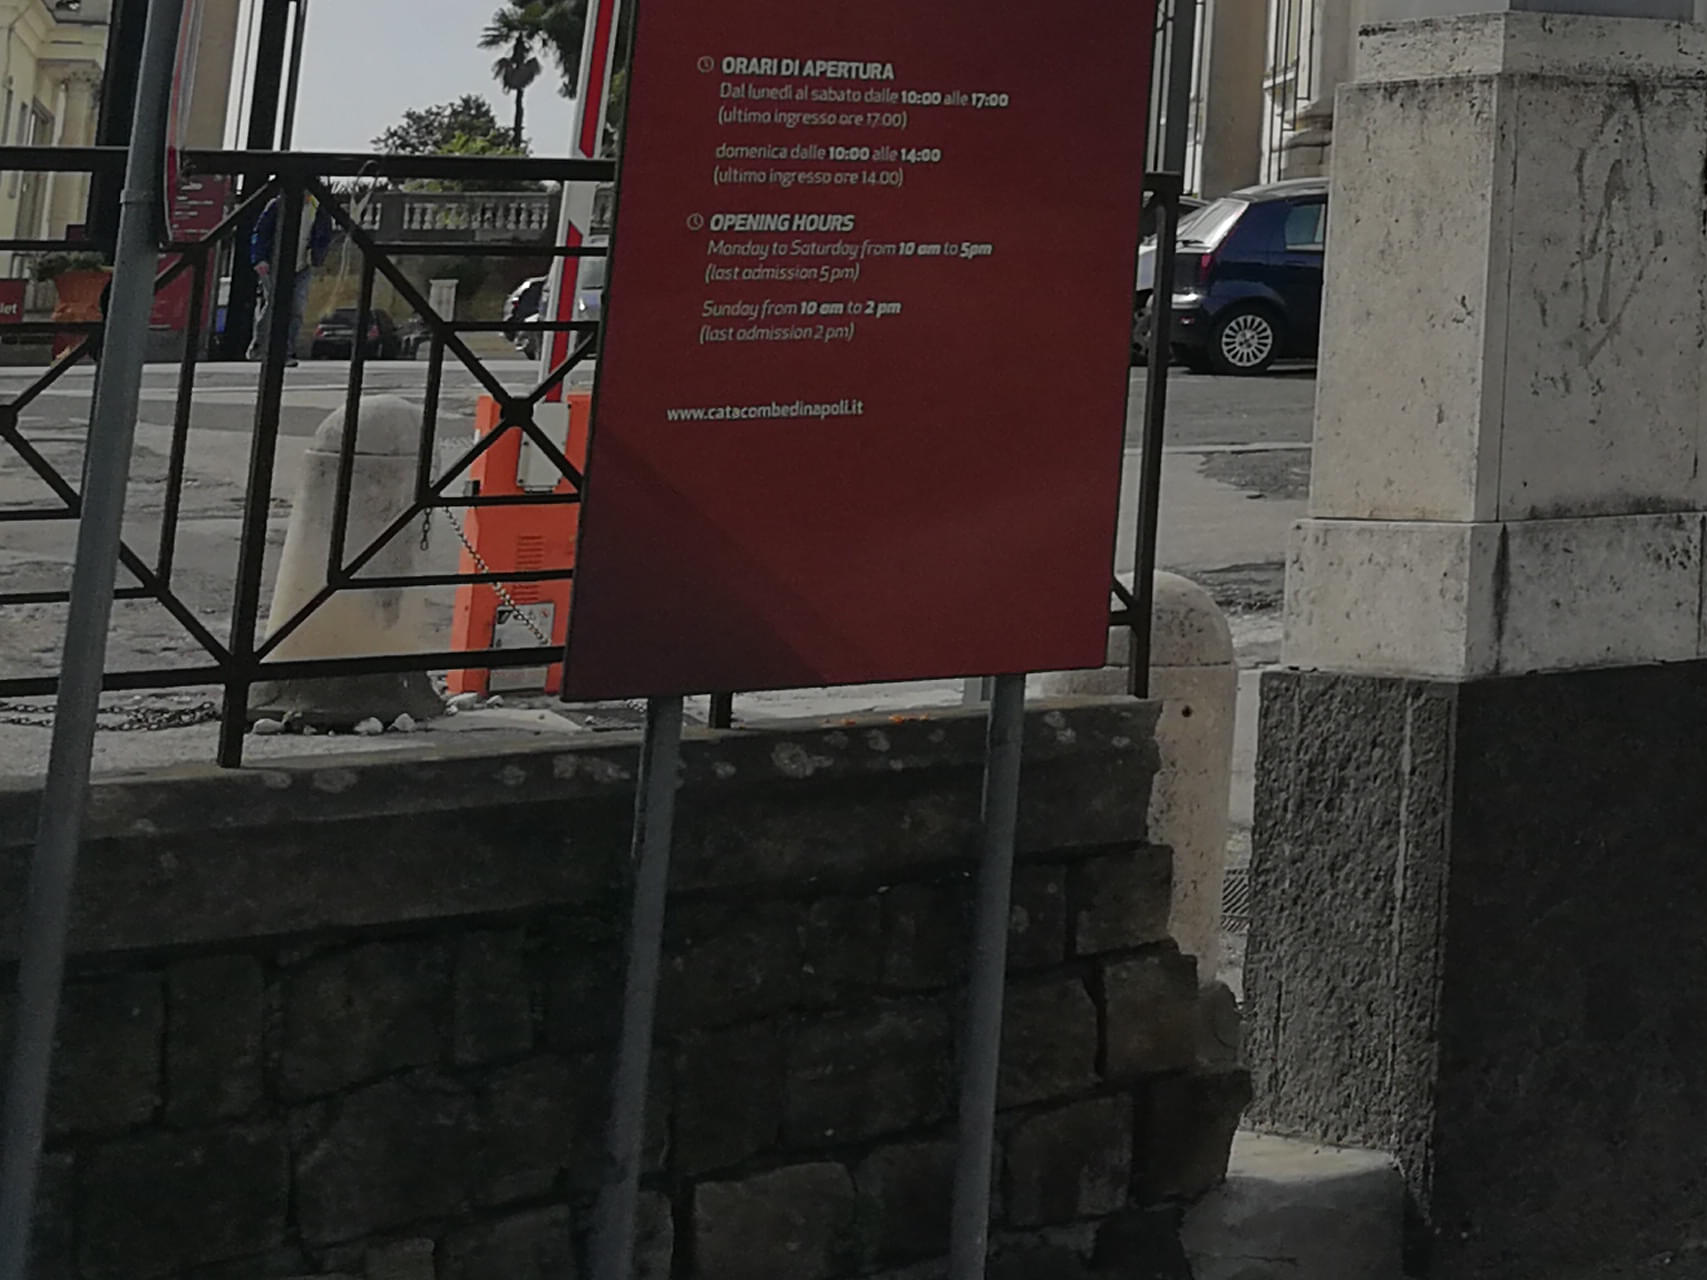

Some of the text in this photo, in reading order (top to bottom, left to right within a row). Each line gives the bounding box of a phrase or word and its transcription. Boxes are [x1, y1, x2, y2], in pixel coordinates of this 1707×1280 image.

[721, 56, 895, 80] ORARI DI APERTURA
[719, 81, 746, 99] Dal
[795, 84, 809, 101] al
[810, 85, 862, 103] sabato
[863, 87, 899, 104] dalle
[901, 90, 942, 106] 10:00
[943, 89, 969, 106] alle
[971, 92, 1010, 109] 17:00
[718, 105, 771, 126] (ultimo
[773, 108, 837, 129] ingresso
[838, 112, 864, 126] ore
[715, 143, 942, 164] domenica dalle 10:00 alle 14:00
[712, 165, 766, 186] (ultimo
[769, 167, 832, 188] ingresso
[833, 170, 859, 185] ore
[709, 213, 856, 233] OPENING HOURS
[706, 238, 993, 261] Monday to Saturday from 10 am to 5pm
[704, 262, 861, 285] (last admission 5 pm)
[702, 298, 902, 320] Sunday from 10 am to 2 pm
[699, 321, 856, 345] (last admission 2 pm)
[666, 399, 864, 421] www.catacombedinapoli.it
